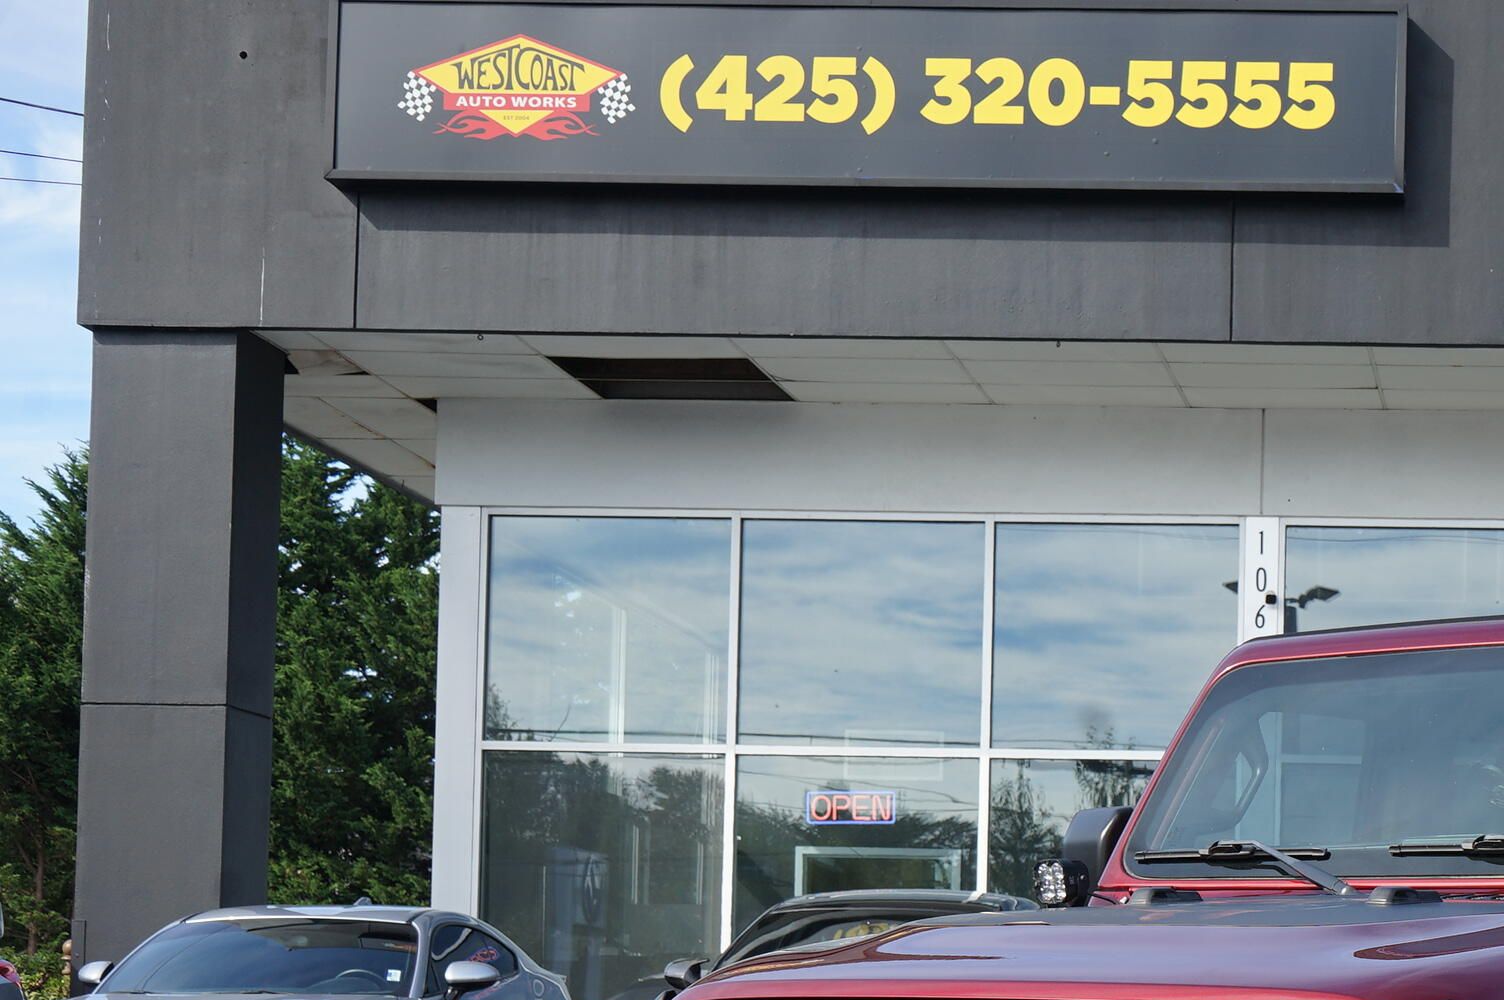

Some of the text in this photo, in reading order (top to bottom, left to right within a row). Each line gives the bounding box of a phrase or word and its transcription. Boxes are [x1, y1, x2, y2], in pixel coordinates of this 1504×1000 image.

[455, 95, 577, 108] AUTO WORKS
[660, 54, 1336, 135] (425) 320-5555
[810, 794, 892, 821] OPEN
